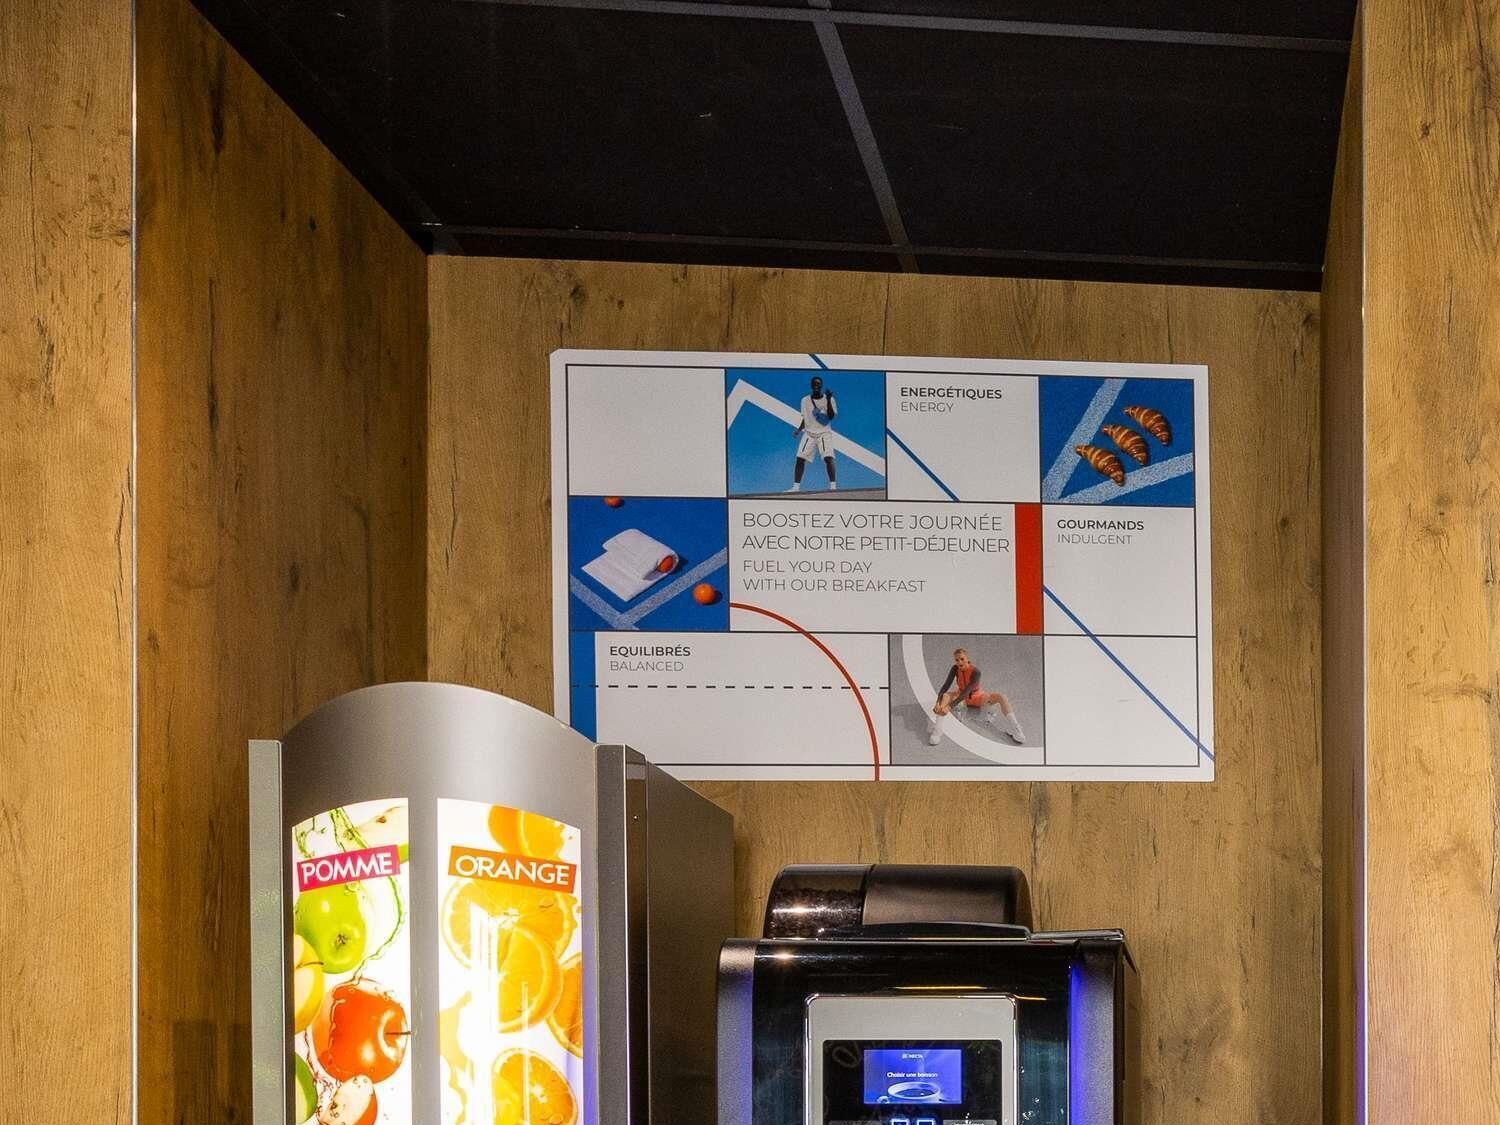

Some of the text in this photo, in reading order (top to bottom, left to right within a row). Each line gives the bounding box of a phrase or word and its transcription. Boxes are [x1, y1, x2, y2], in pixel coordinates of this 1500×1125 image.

[900, 386, 1002, 400] ENERGÉTIQUES
[900, 402, 954, 413] ENERGY
[743, 512, 1003, 531] BOOSTEZ VOTRE JOURNÉE
[1057, 519, 1145, 531] GOURMANDS
[742, 534, 1010, 553] AVEC NOTRE PETIT-DÉJEUNER
[1057, 533, 1133, 545] INDULGENT
[743, 560, 873, 574] FUEL YOUR DAY
[743, 578, 927, 593] WITH OUR BREAKFAST
[609, 644, 692, 657] EQUILIBRÉS
[609, 660, 685, 672] BALANCED
[302, 852, 393, 884] POMME
[455, 855, 569, 886] ORANGE
